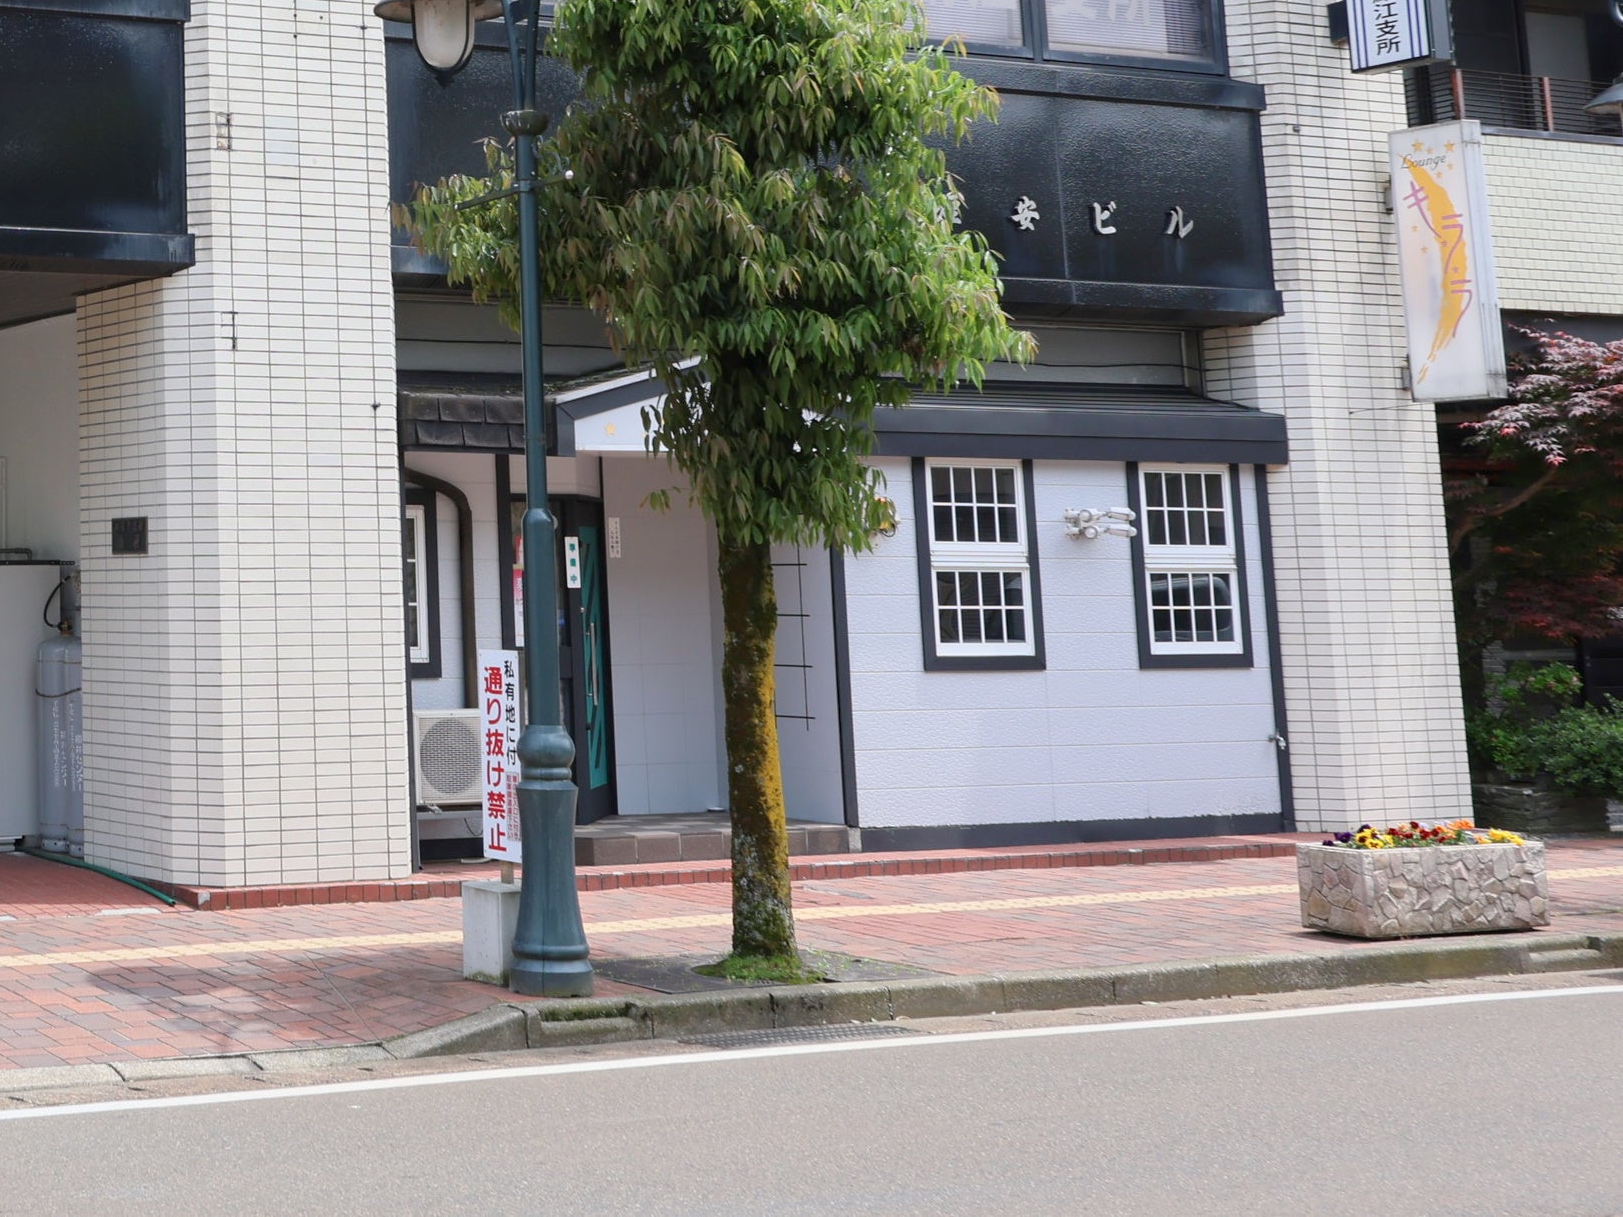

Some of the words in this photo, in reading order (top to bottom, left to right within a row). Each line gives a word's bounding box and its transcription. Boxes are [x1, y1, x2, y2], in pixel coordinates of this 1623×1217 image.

[1400, 152, 1447, 170] Lounge
[1402, 180, 1472, 338] キララ
[568, 543, 577, 584] 準備中
[483, 666, 507, 854] 通り抜け禁止
[504, 659, 518, 766] 私有地に付
